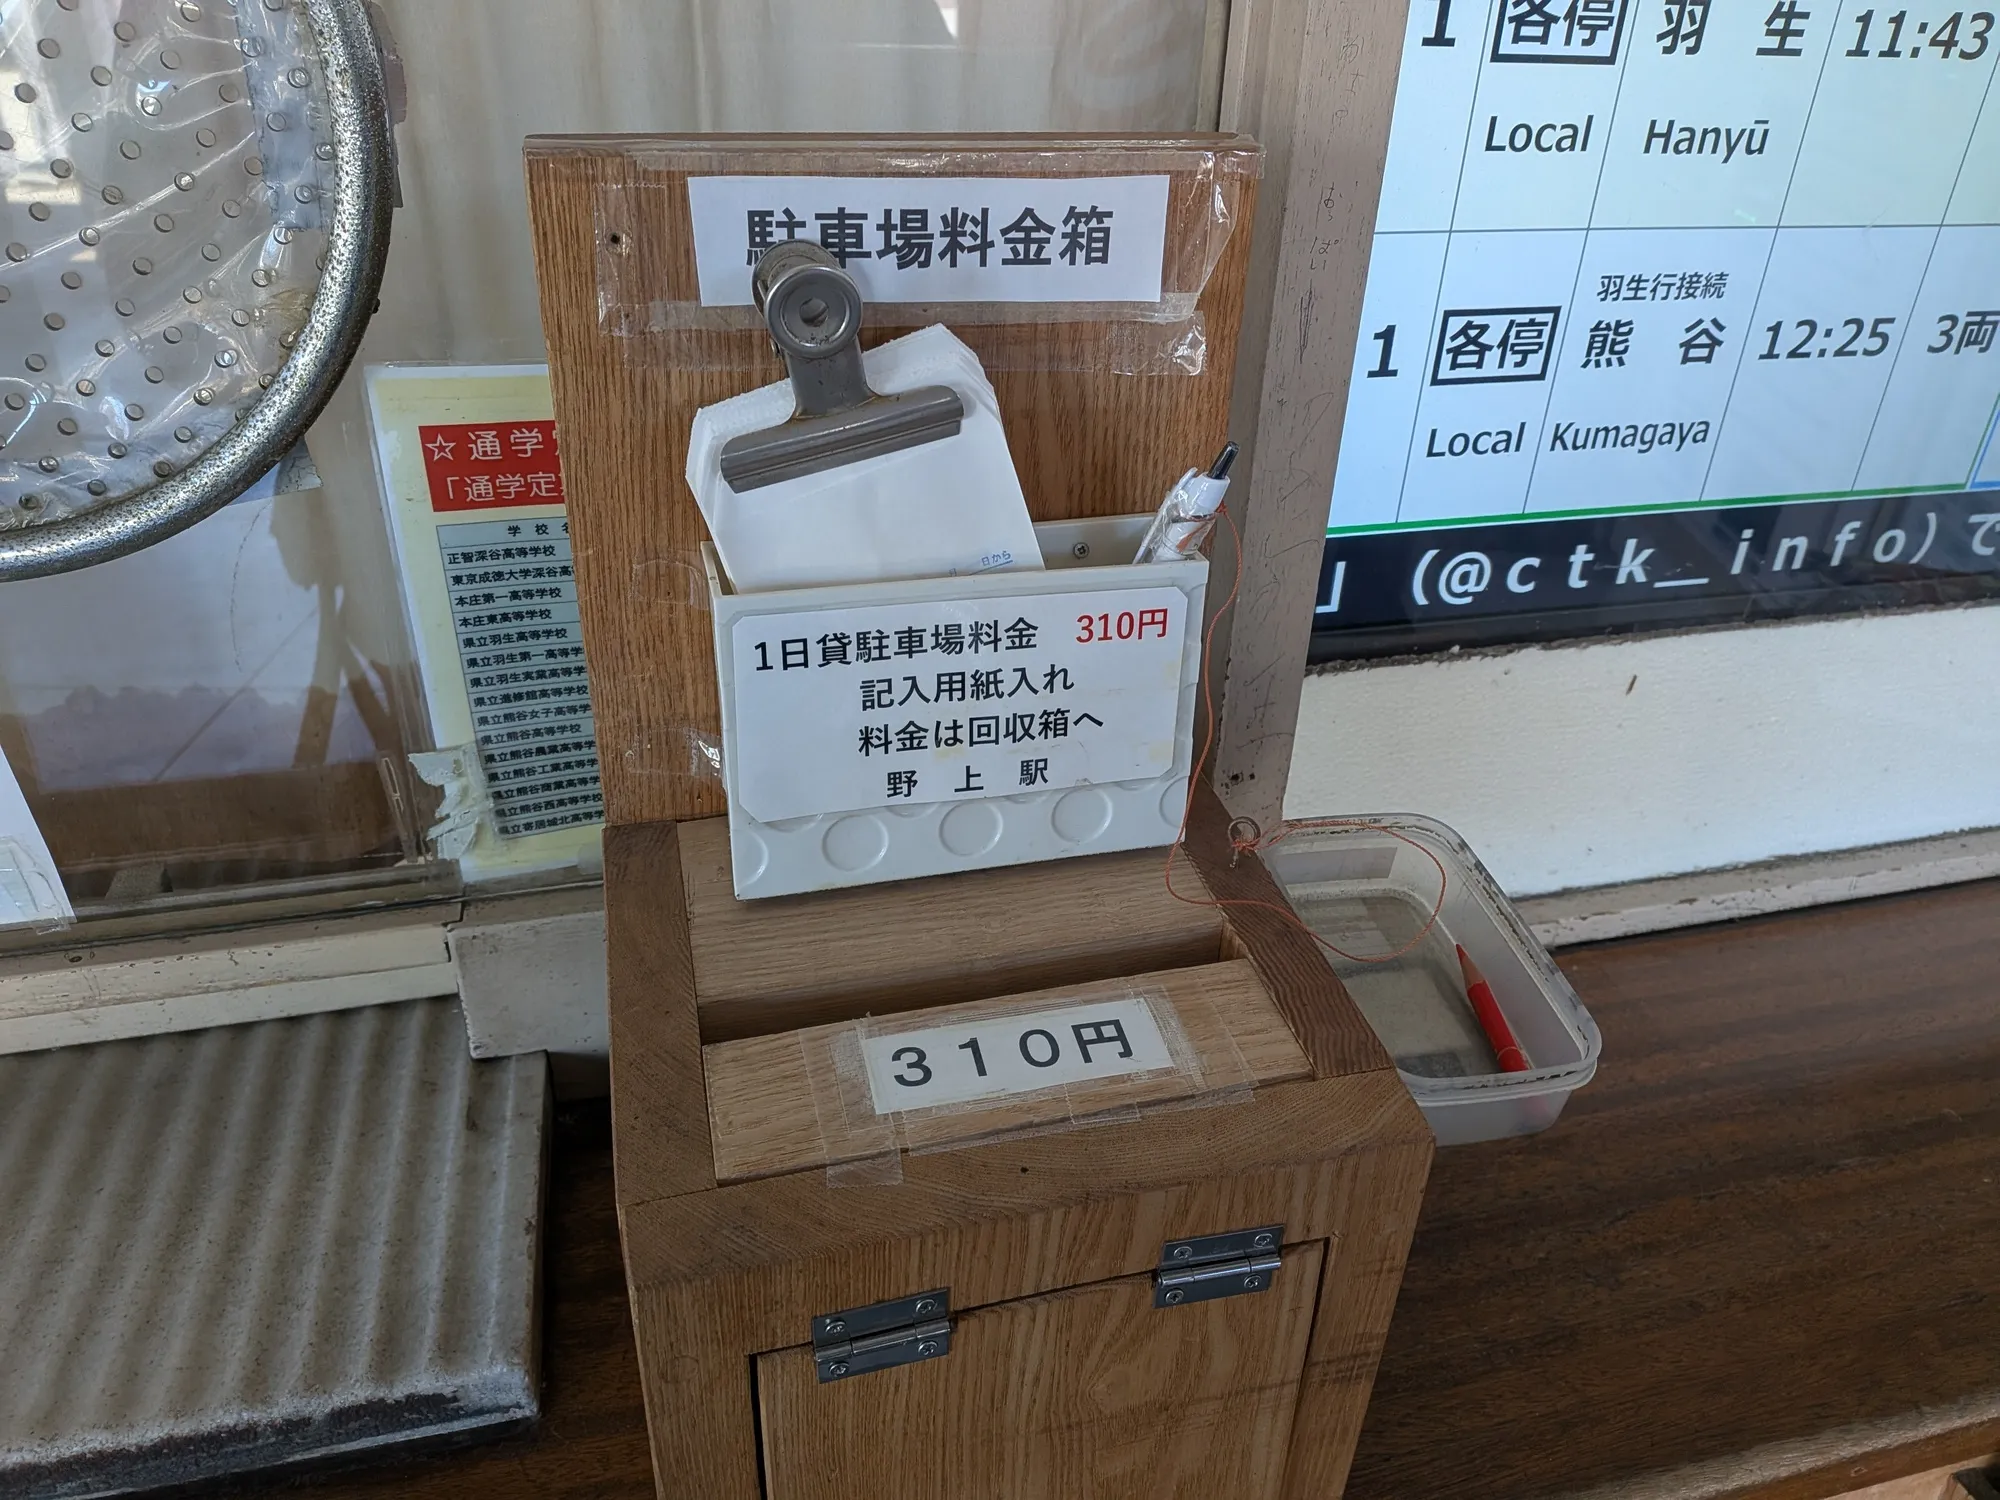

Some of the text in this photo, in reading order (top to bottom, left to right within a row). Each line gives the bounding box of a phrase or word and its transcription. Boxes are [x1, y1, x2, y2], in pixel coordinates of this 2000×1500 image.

[1421, 0, 1456, 47] 1
[1507, 0, 1615, 47] 各停
[1845, 9, 1995, 60] 11:43
[1484, 115, 1769, 164] Local Hanyū
[746, 204, 1114, 270] 駐車場料金箱
[1596, 272, 1729, 301] 羽生行接続
[1366, 324, 1398, 378] 1
[1446, 318, 1549, 371] 各停
[1758, 317, 1895, 360] 12:25
[1927, 310, 2000, 355] 3両
[1426, 420, 1711, 458] Local Kumagaya
[446, 471, 566, 502] 「通学定
[447, 545, 556, 565] 正智深谷高等学校
[450, 565, 574, 586] 東京成徳大学深谷高
[454, 587, 562, 608] 本庄第一高等学校
[458, 608, 552, 628] 本庄東高等学校
[462, 628, 568, 649] 県立羽生高等学校
[753, 608, 1168, 672] 1日貸駐車場料金 310円
[466, 647, 584, 669] 県立羽生第一高等学
[859, 664, 1075, 711] 記入用紙入れ
[480, 723, 582, 746] 県立熊谷高等学校
[858, 708, 1104, 757] 料金は回収箱へ
[891, 1019, 1133, 1087] 310円
